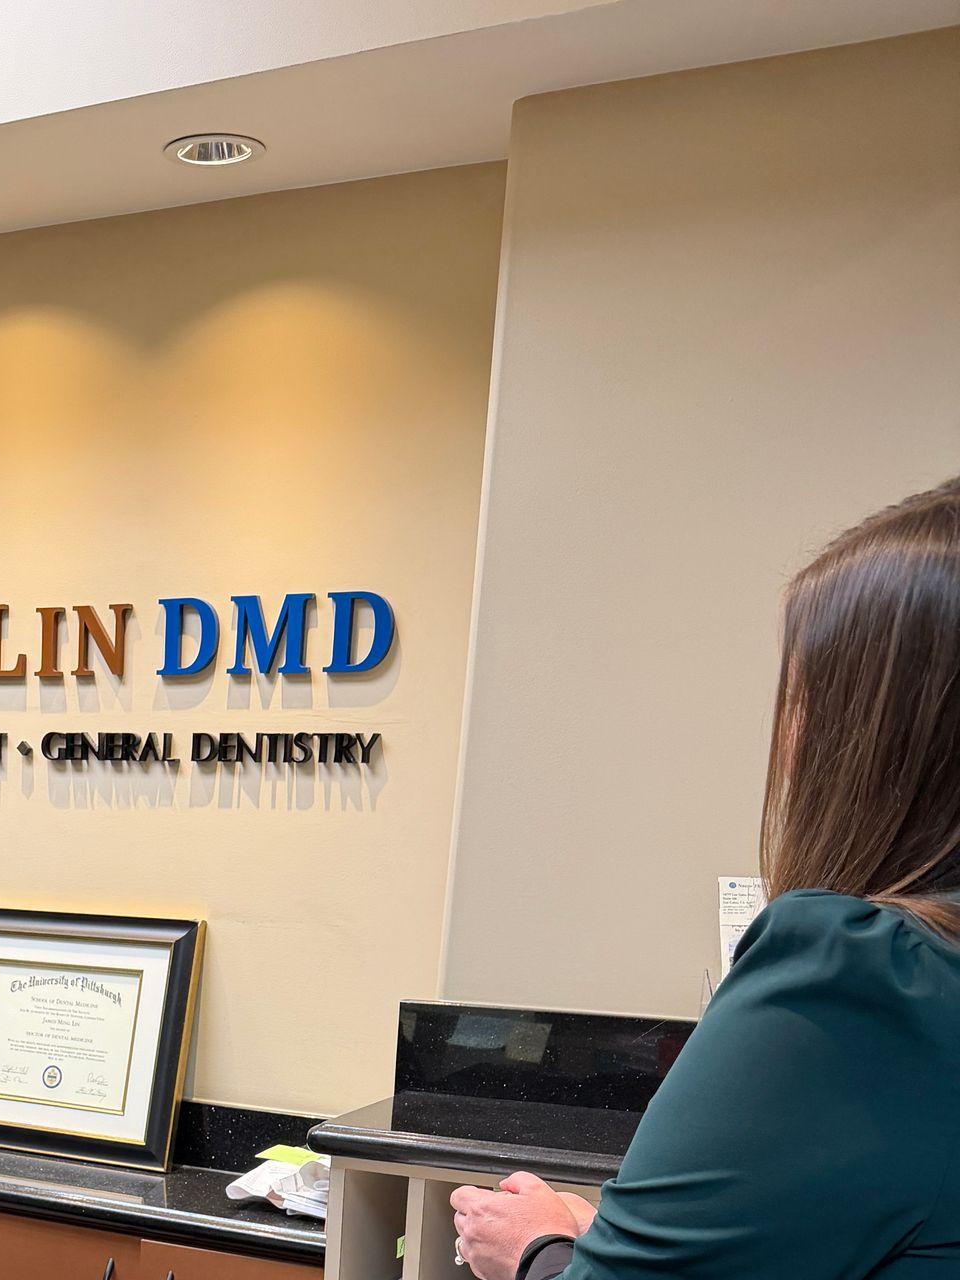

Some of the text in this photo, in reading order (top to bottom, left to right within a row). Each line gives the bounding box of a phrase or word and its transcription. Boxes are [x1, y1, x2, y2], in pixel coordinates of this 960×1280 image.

[156, 591, 395, 676] DMD
[41, 732, 180, 762] GENERAL
[191, 732, 381, 763] DENTISTRY
[10, 976, 122, 1008] The University of Pittsburgh
